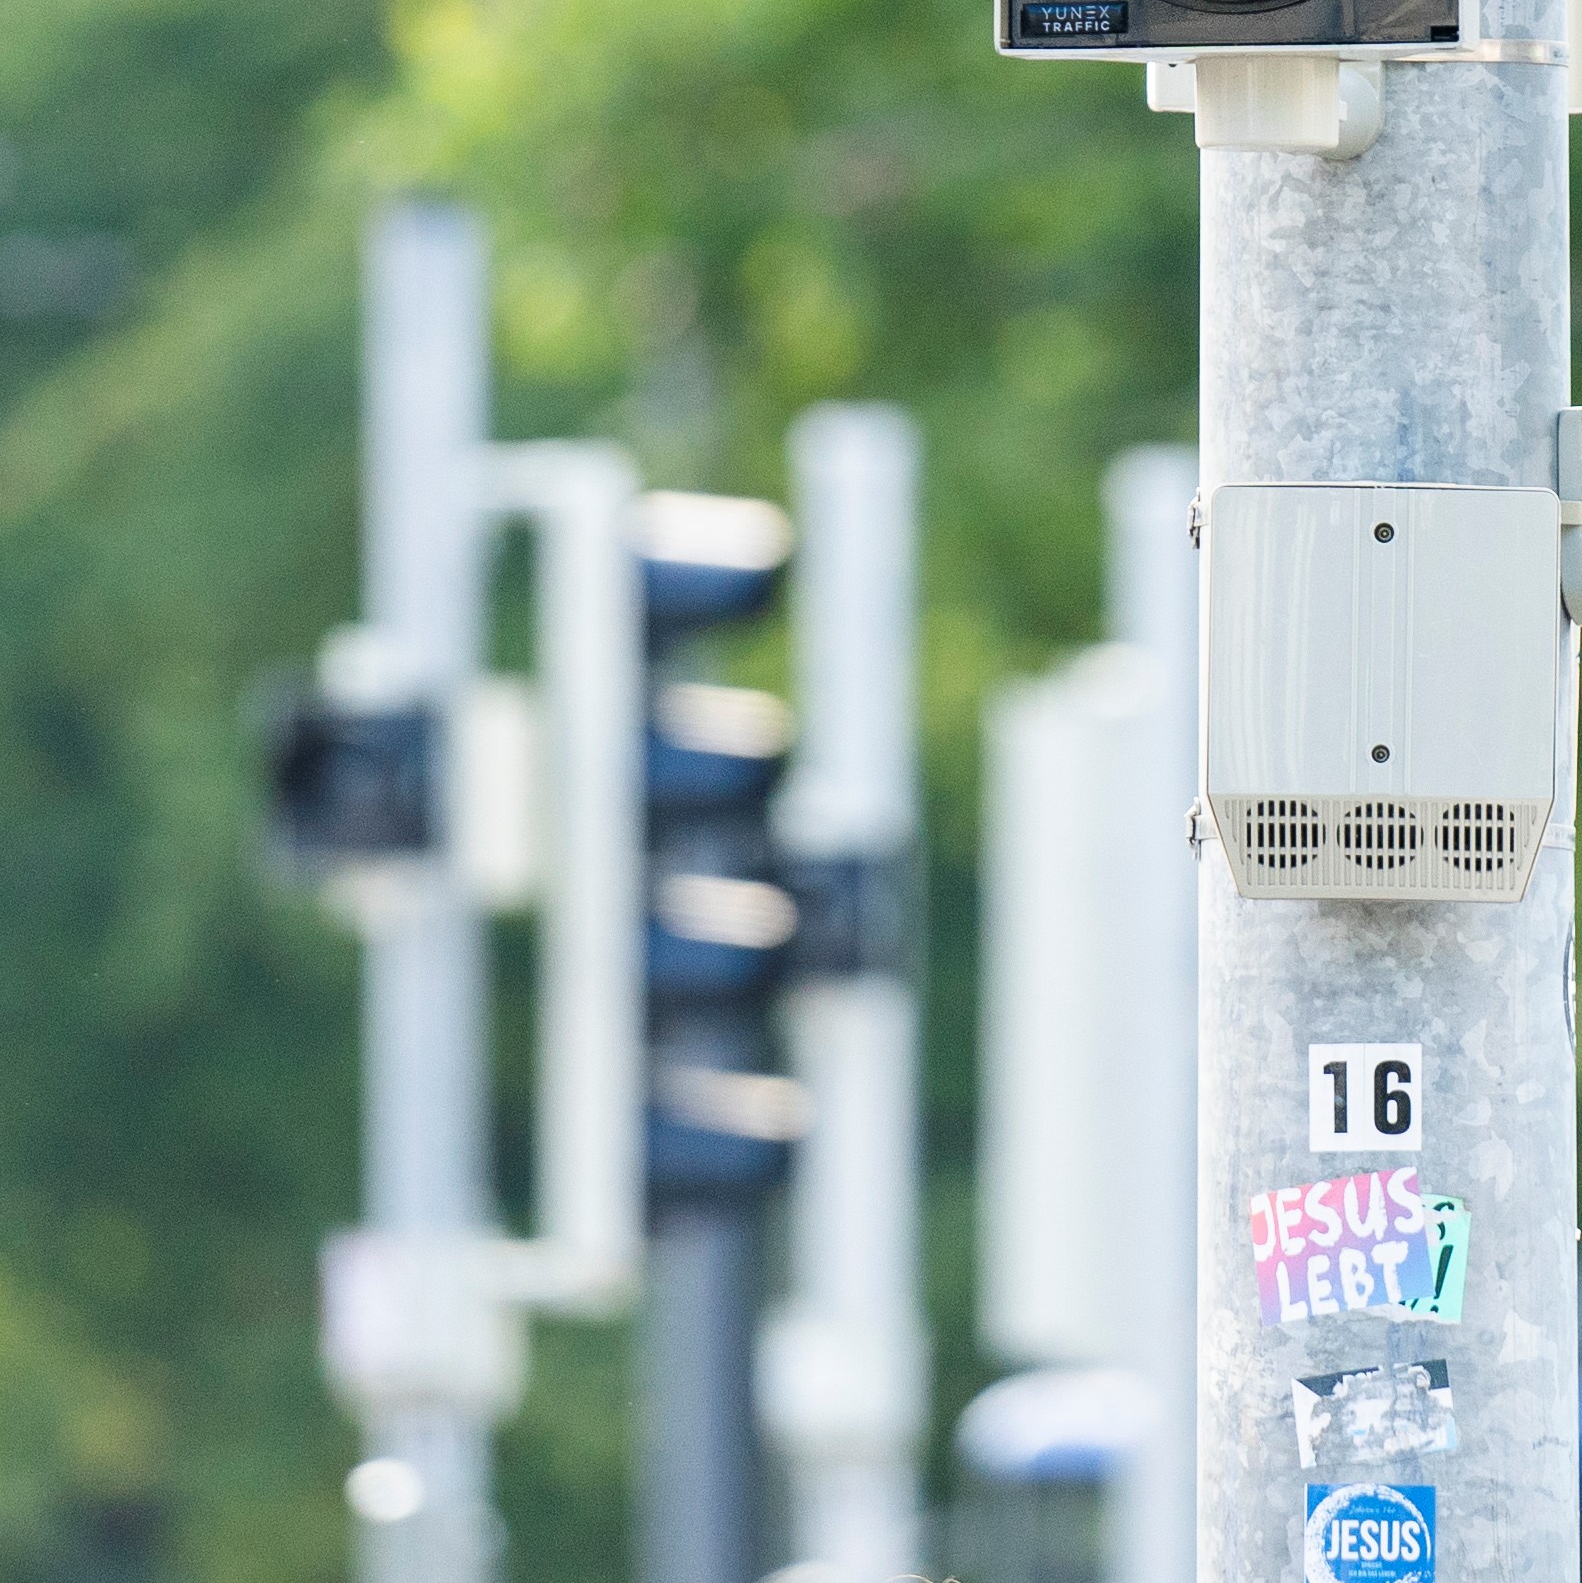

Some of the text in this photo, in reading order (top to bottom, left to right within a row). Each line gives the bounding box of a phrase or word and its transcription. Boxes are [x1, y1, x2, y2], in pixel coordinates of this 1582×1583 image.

[1041, 5, 1110, 20] YUNEX
[1042, 20, 1110, 32] TRAFFIC
[1323, 1059, 1412, 1135] 16
[1250, 1166, 1425, 1262] JESUS
[1275, 1240, 1409, 1322] LEBT
[1325, 1519, 1421, 1562] JESUS
